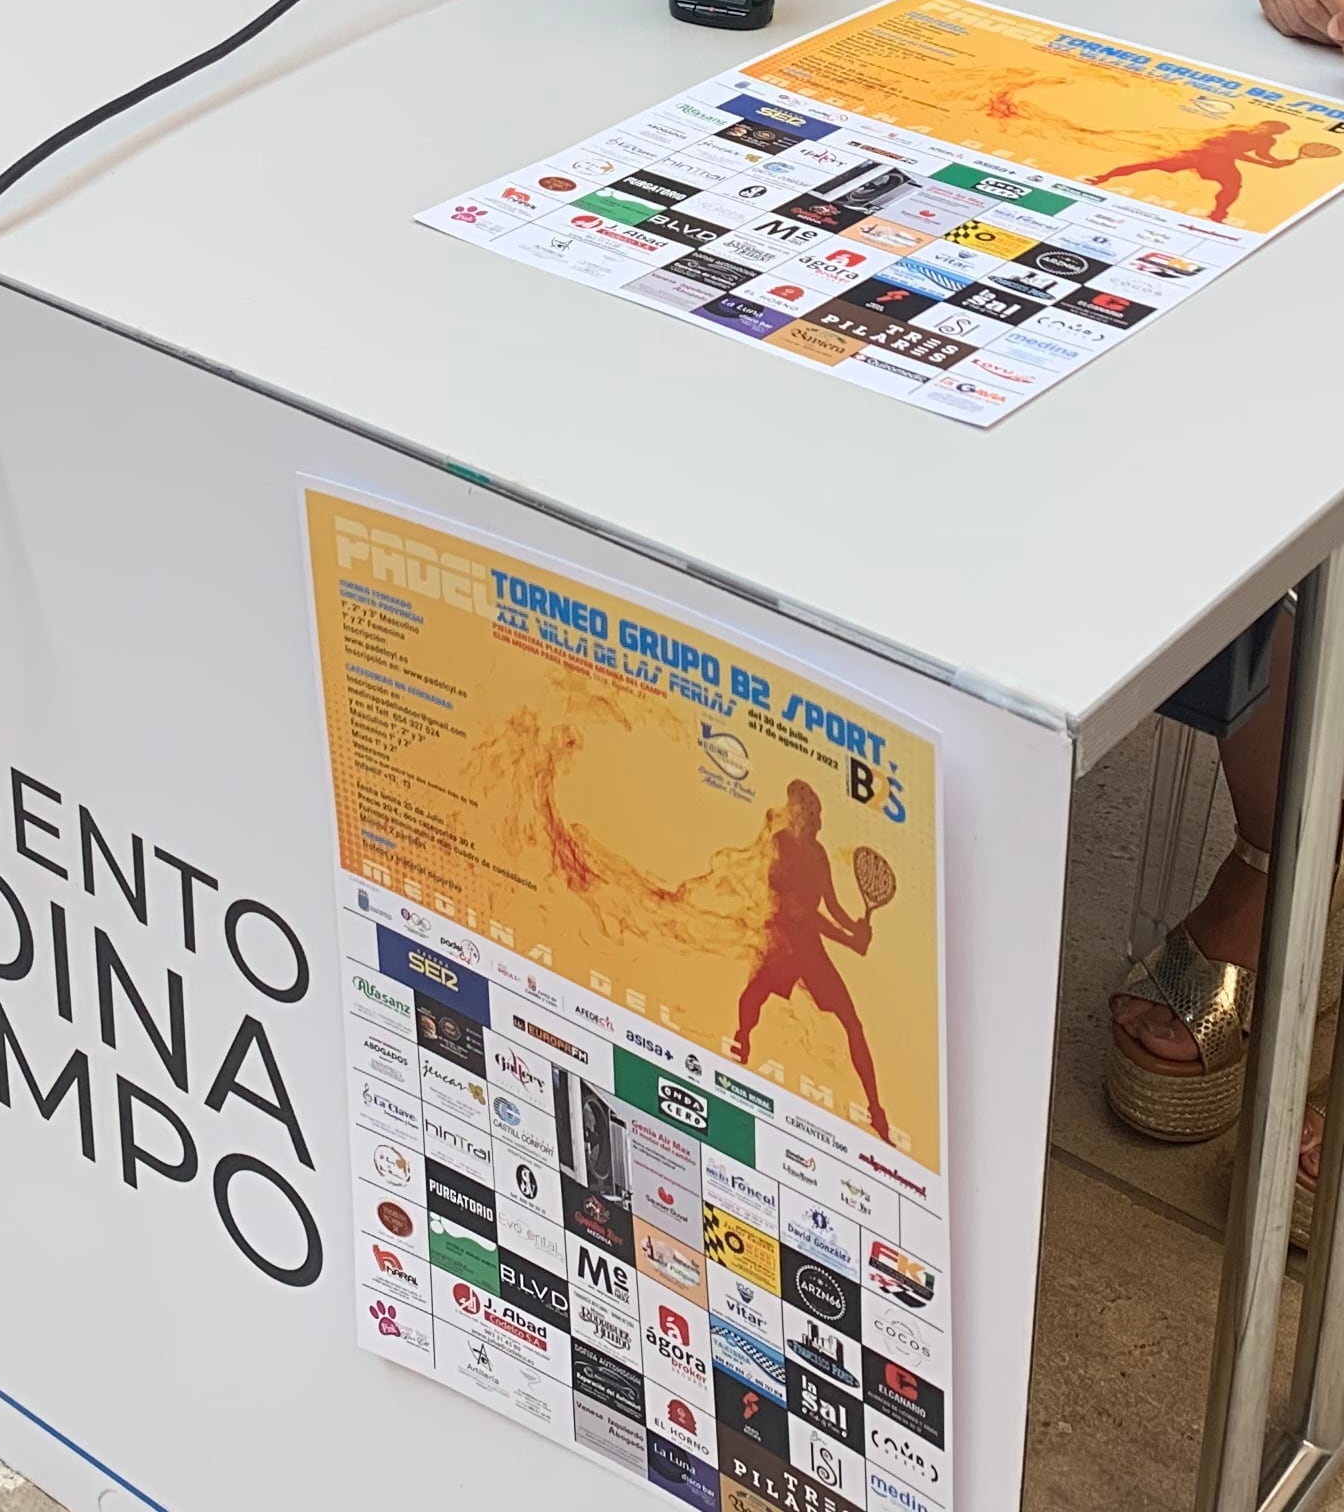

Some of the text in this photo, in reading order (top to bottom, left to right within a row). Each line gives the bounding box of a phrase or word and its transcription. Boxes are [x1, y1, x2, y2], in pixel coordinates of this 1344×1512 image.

[1056, 34, 1152, 66] TORNEO
[1155, 62, 1242, 91] GRUPO
[755, 106, 807, 128] SER
[626, 229, 668, 249] Abad
[647, 214, 718, 242] BLVD
[798, 254, 860, 281] ágora
[820, 314, 945, 363] PILARES
[886, 324, 959, 355] TRES
[334, 515, 498, 623] PADEL
[491, 568, 886, 766] TORNEO GRUPO B2 SPORT
[595, 663, 624, 682] MEDINA
[748, 708, 808, 744] del 30 de julio
[766, 728, 776, 738] de
[778, 735, 808, 755] agosto
[816, 753, 839, 770] 2022
[408, 951, 459, 992] SER
[364, 1040, 408, 1066] ABOGADOS
[664, 1086, 702, 1110] ONDA
[666, 1103, 702, 1126] CERO
[672, 1139, 690, 1156] Max
[429, 1179, 494, 1222] PURGATORIO
[500, 1264, 569, 1312] BLVD
[483, 1298, 547, 1339] J. Abad
[725, 1299, 765, 1328] vitar
[646, 1326, 706, 1374] ágora
[874, 1319, 931, 1357] COCOS
[654, 1417, 710, 1456] EL HORNO
[653, 1443, 666, 1459] La
[670, 1450, 695, 1476] Luna
[783, 1471, 850, 1512] TRE
